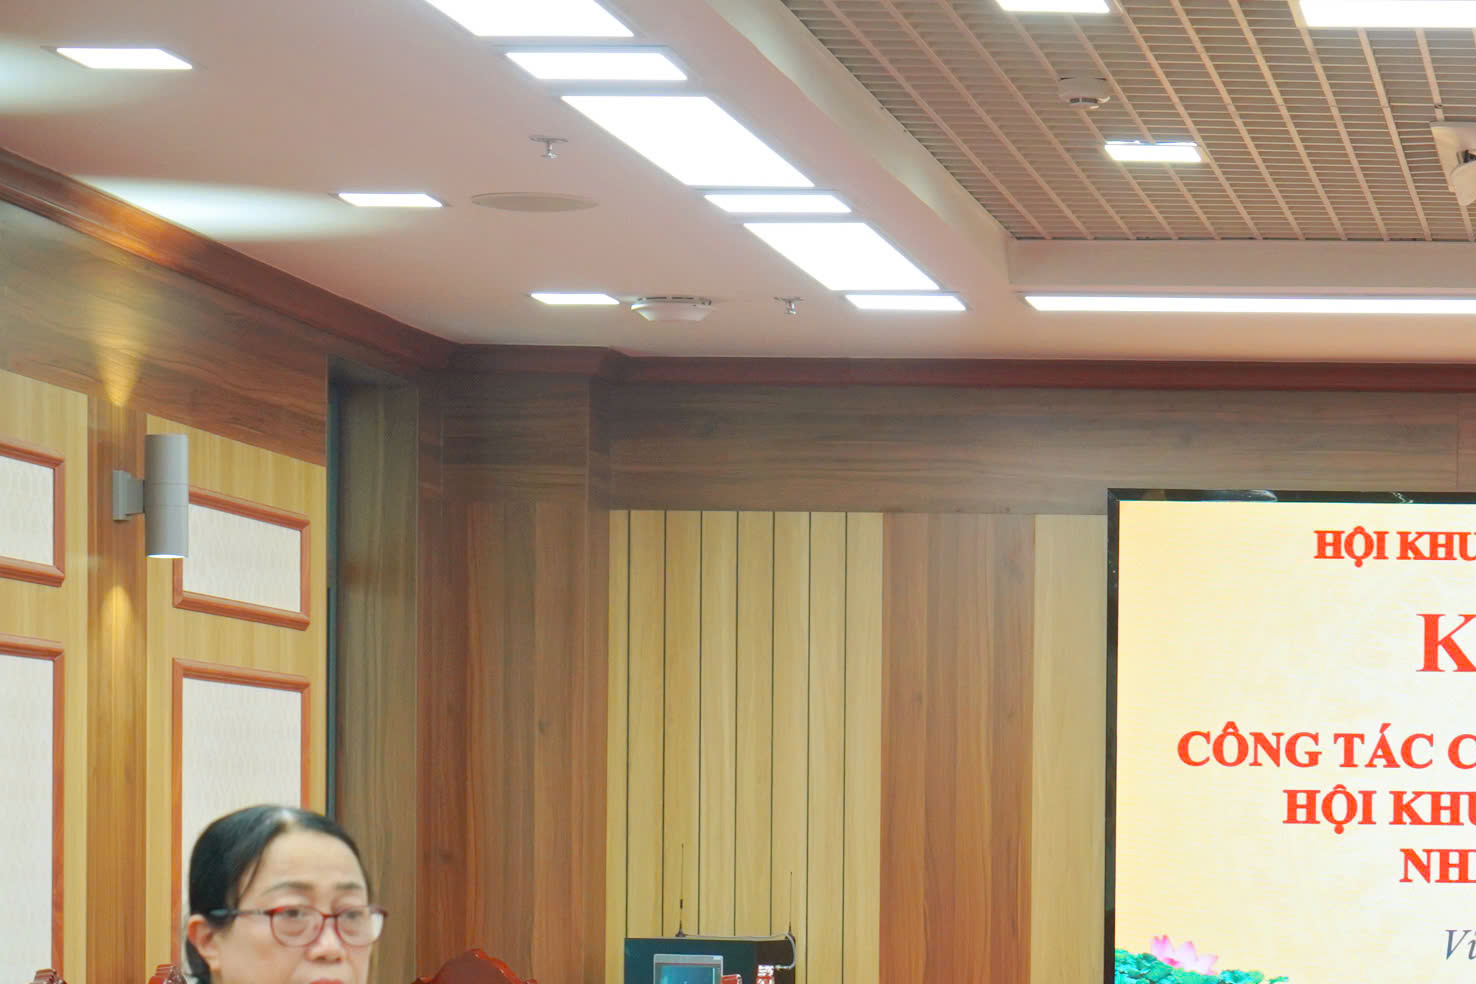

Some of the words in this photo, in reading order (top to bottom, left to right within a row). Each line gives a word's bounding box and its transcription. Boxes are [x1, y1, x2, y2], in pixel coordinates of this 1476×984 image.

[1313, 525, 1389, 568] HỘI
[1177, 721, 1322, 768] CÔNG
[1333, 723, 1434, 769] TÁC
[1282, 783, 1376, 835] HỘI
